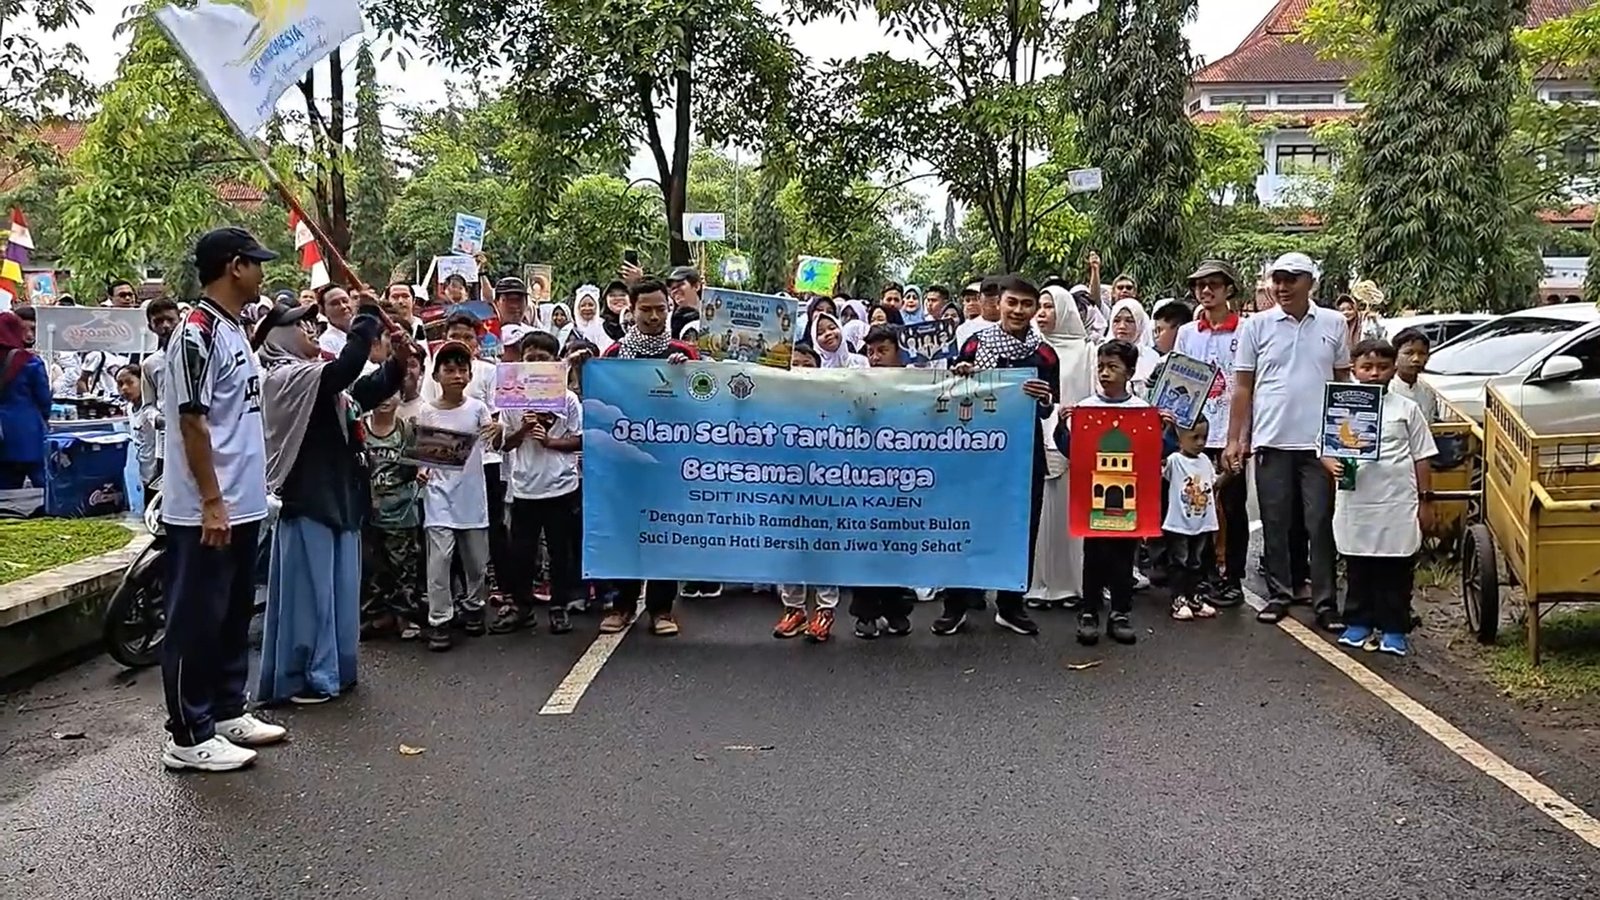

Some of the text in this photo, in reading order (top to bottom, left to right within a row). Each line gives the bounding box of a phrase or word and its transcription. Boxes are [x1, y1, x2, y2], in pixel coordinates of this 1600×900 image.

[613, 418, 1007, 451] Jalan Sehat Tarhib Ramdhan
[682, 457, 935, 491] Bersama keluarga
[689, 489, 922, 508] SDIT INSAN MULIA KAJEN
[707, 512, 755, 527] Tarhib
[759, 514, 833, 531] Ramdhan,
[836, 517, 866, 530] Kita
[870, 517, 925, 531] Sambut
[929, 518, 971, 531] Bulan
[639, 531, 669, 544] Suci
[672, 532, 726, 548] Dengan
[730, 535, 760, 549] Hati
[764, 536, 809, 550] Bersih
[813, 537, 840, 551] dan
[844, 539, 878, 552] Jiwa
[881, 539, 917, 555] Yang
